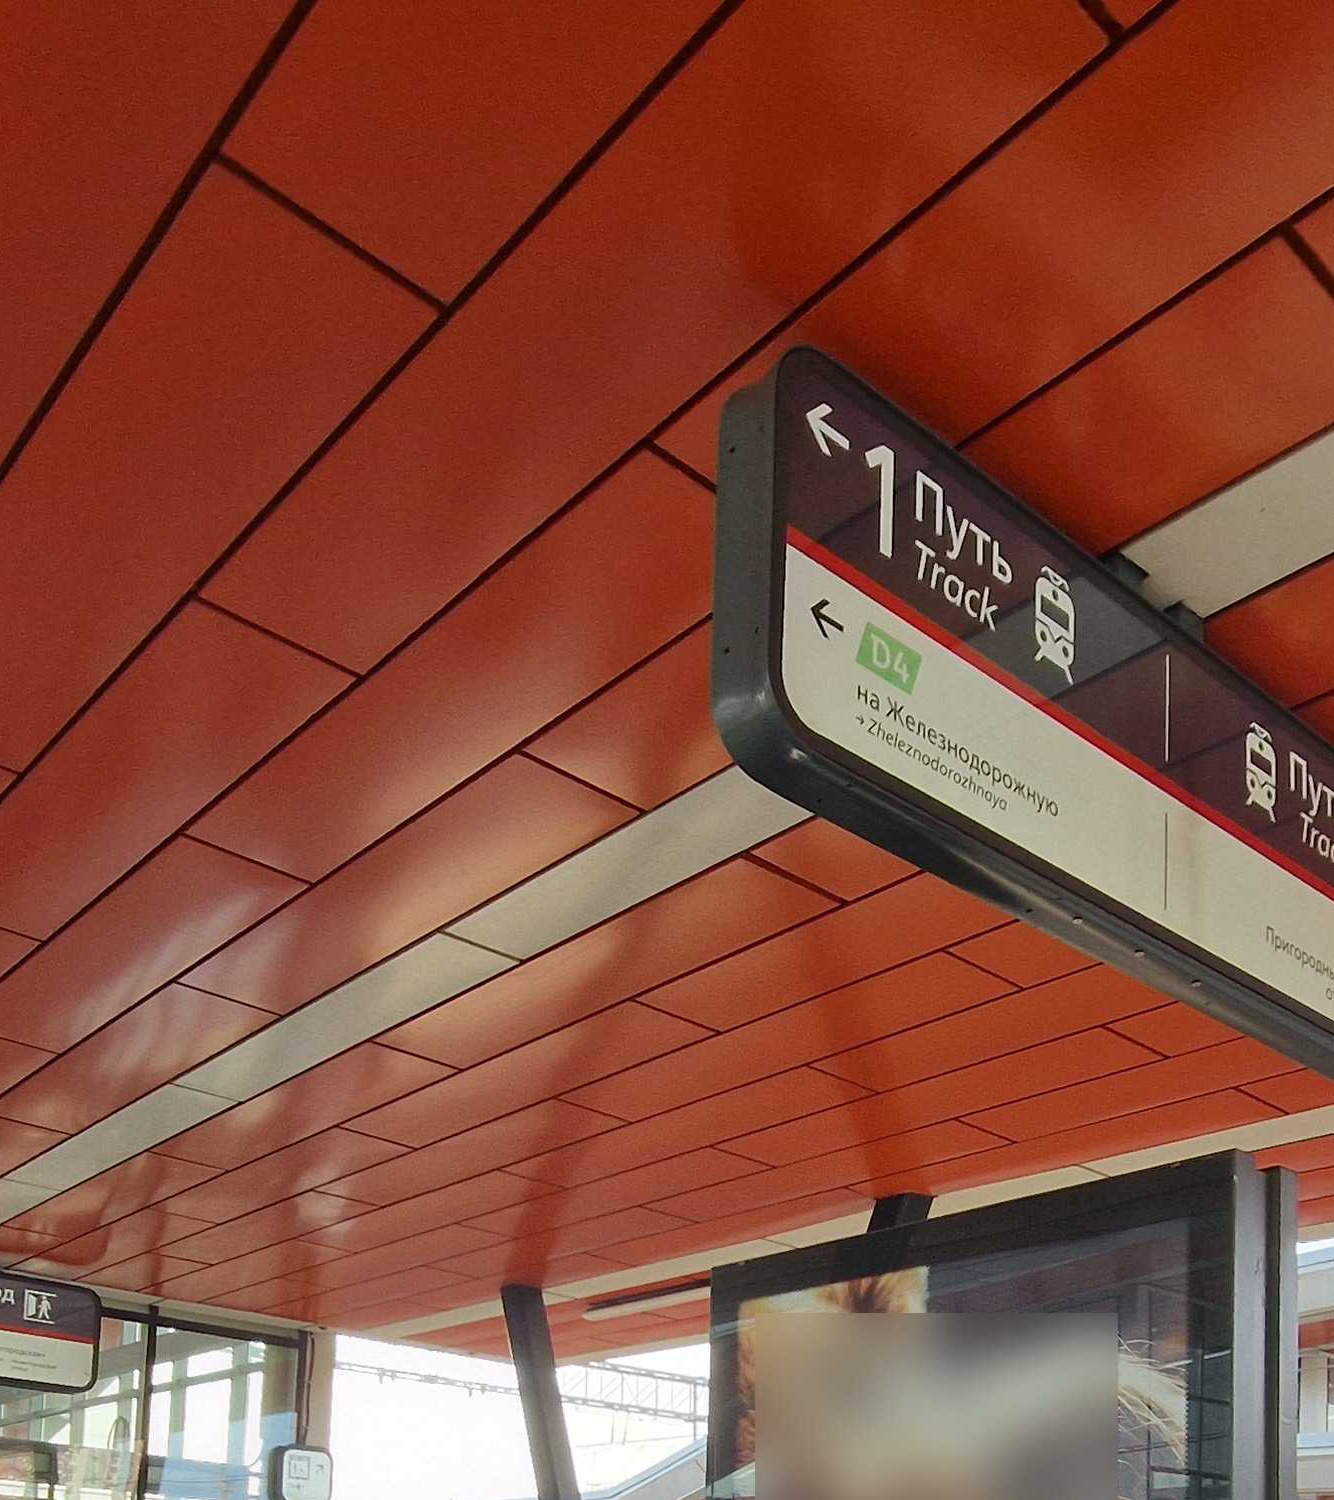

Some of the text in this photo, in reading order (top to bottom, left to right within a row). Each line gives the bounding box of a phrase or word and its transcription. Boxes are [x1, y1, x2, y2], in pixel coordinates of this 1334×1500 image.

[865, 444, 895, 559] 1
[915, 470, 1013, 584] Путь
[914, 539, 999, 632] Track
[869, 632, 910, 683] D4
[857, 684, 1059, 817] на Железнодорожную
[867, 718, 1008, 811] Zheleznodorozhnaya
